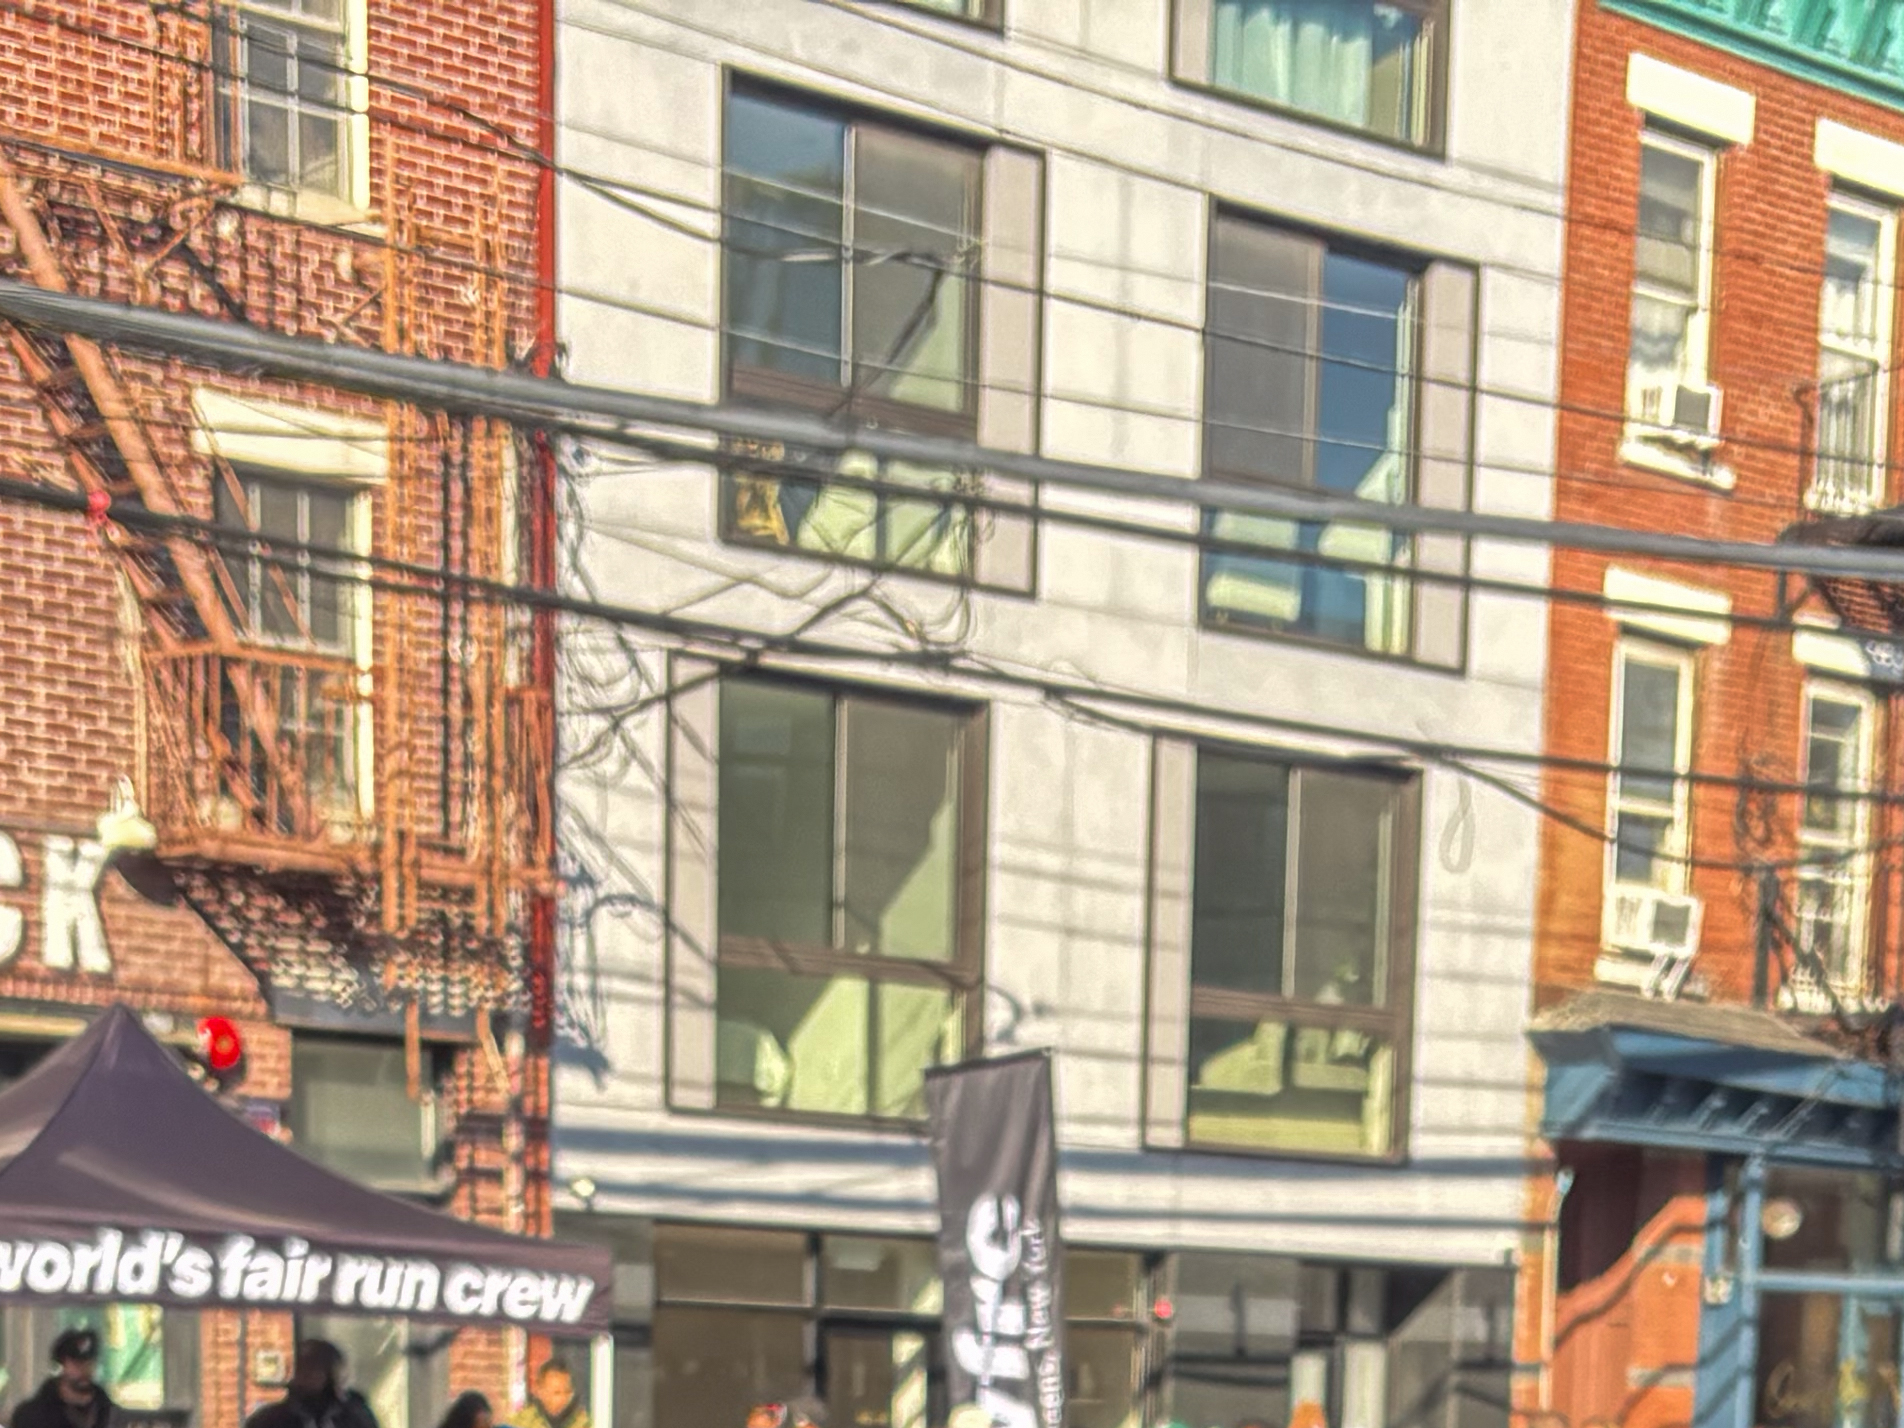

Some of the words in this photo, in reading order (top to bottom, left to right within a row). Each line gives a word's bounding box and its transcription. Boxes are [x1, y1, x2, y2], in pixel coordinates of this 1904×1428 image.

[216, 1233, 331, 1303] fair
[334, 1253, 440, 1311] run
[443, 1262, 594, 1324] crew
